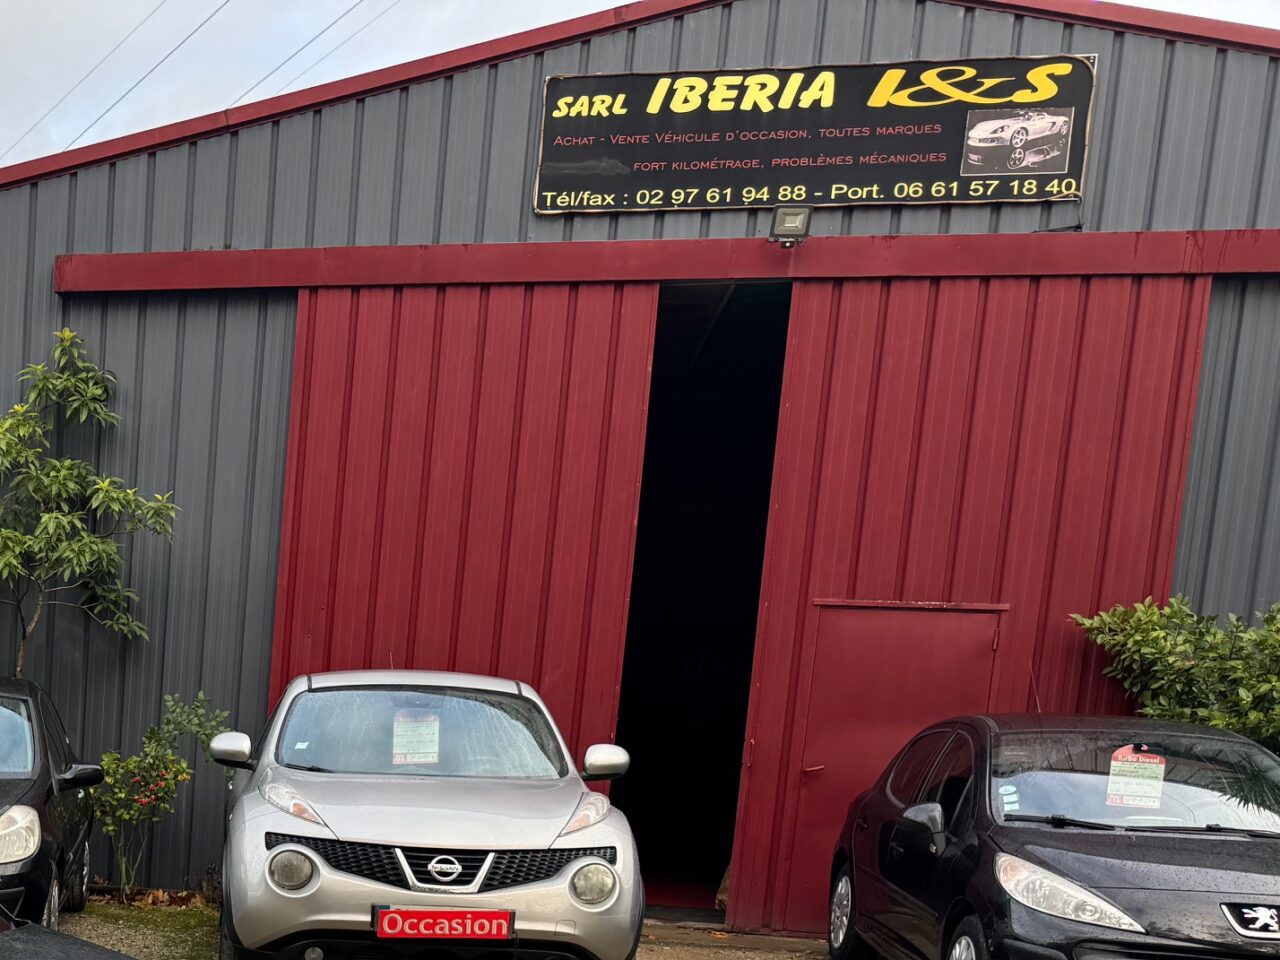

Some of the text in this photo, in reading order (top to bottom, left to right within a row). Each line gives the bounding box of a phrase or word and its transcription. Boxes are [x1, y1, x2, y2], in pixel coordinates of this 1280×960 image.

[552, 94, 628, 118] SARL
[646, 71, 836, 114] IBERIA
[819, 127, 870, 138] TOUTES
[876, 124, 942, 136] MARQUES
[634, 161, 667, 171] FORT
[542, 190, 615, 207] Tél/fax
[636, 189, 664, 205] 02
[671, 188, 699, 204] 97
[706, 187, 731, 203] 61
[742, 186, 770, 202] 94
[778, 185, 807, 201] 88
[831, 183, 884, 200] Port.
[893, 182, 923, 198] 06
[931, 181, 958, 196] 61
[969, 180, 1000, 196] 57
[1010, 179, 1037, 195] 18
[1045, 178, 1077, 195] 40
[382, 913, 508, 935] Occasion
